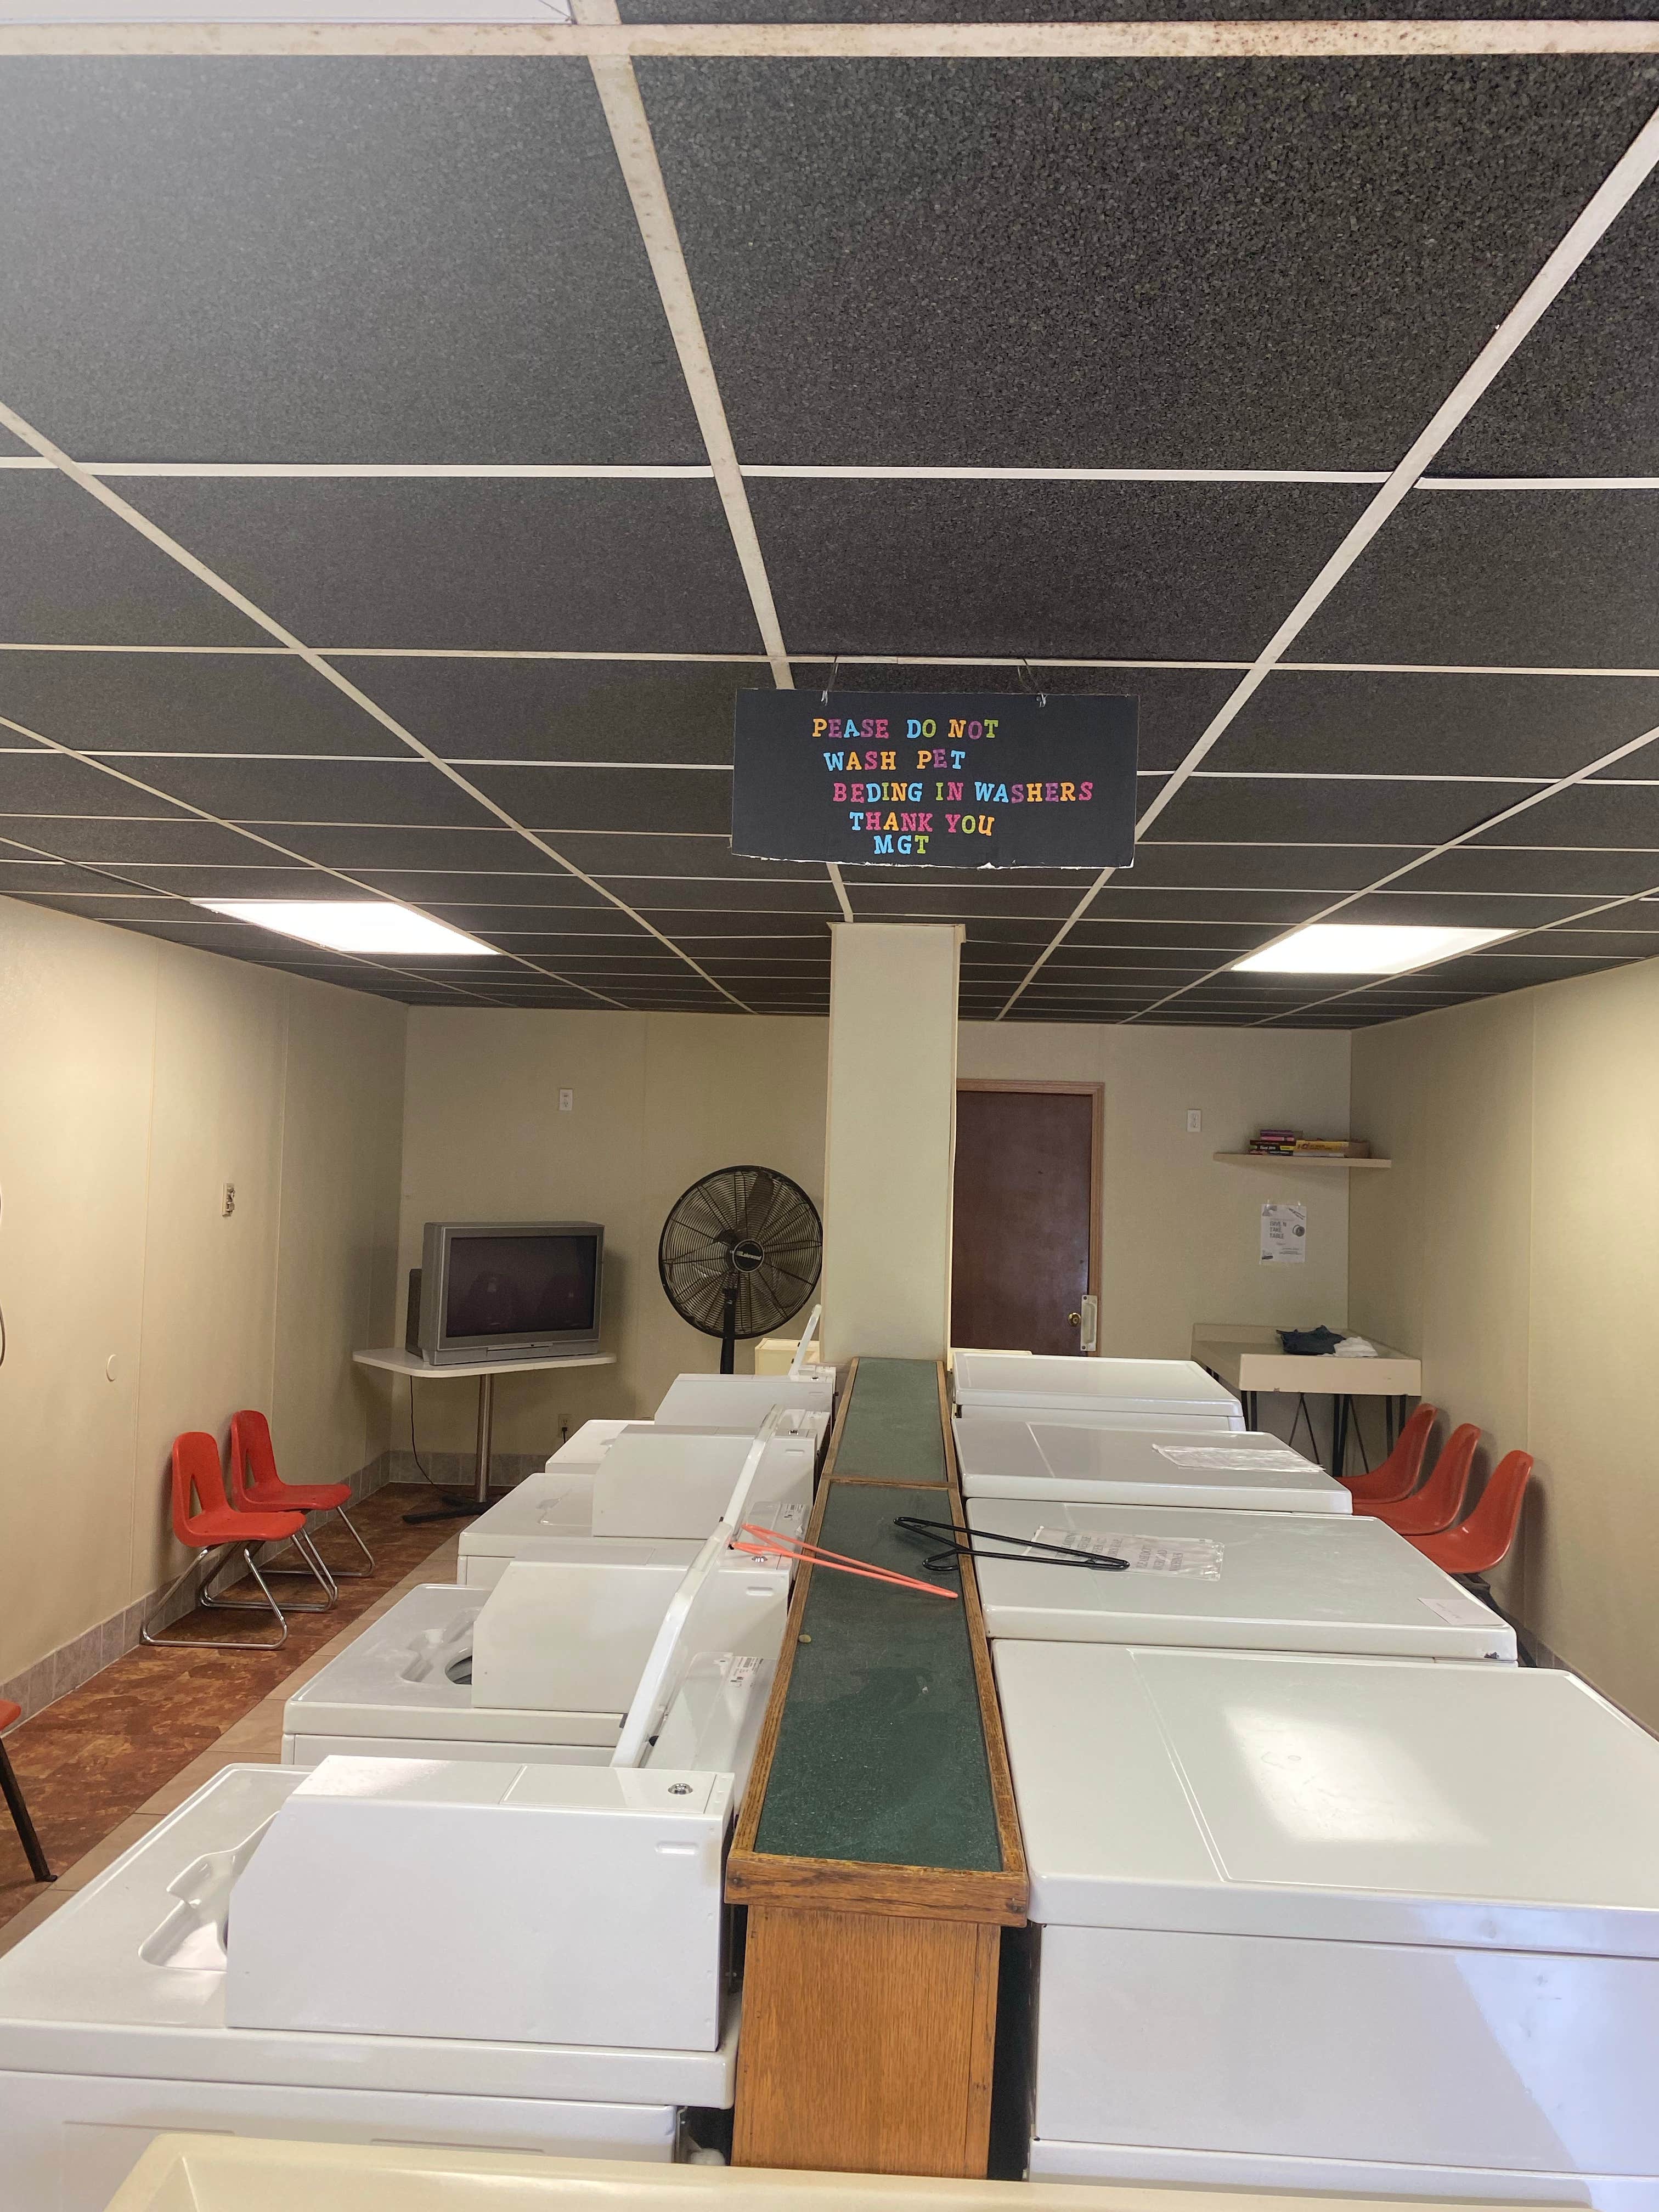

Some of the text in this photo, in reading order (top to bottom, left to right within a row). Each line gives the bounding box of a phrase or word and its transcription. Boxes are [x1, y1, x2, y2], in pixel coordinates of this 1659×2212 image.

[812, 718, 999, 740] PEASE DO NOT
[823, 748, 966, 771] WASH PET
[833, 781, 1094, 804] BEDING IN WASHERS
[849, 811, 995, 837] THANK YOU
[873, 834, 929, 855] MGT
